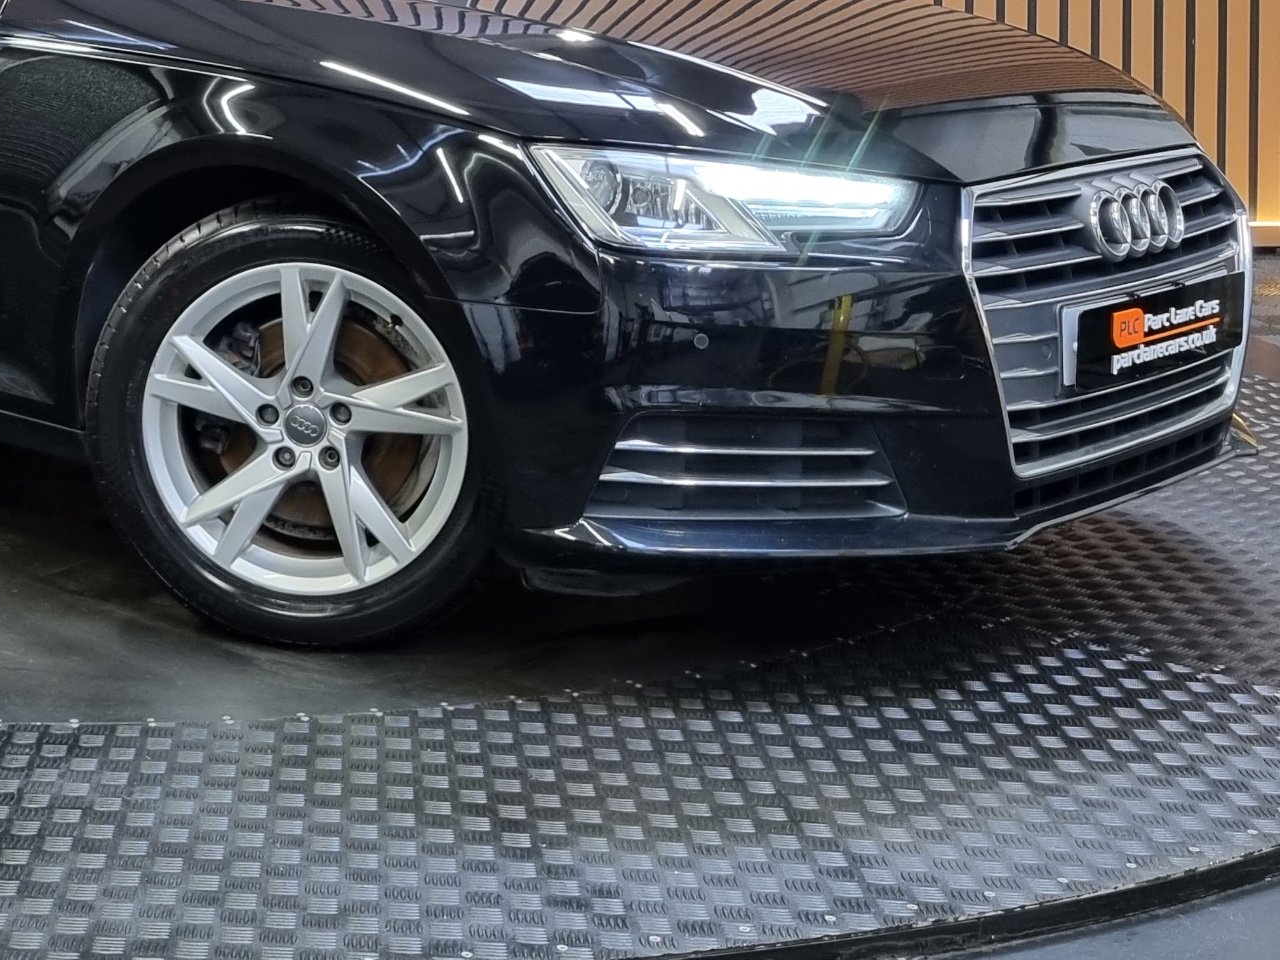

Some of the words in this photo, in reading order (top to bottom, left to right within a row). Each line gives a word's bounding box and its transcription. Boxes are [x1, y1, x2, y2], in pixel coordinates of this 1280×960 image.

[1120, 318, 1140, 337] PLC
[1144, 313, 1170, 332] Parc
[1170, 305, 1195, 324] Lane
[1195, 299, 1220, 318] Cars
[1111, 325, 1217, 375] parclanecars.co.uk
